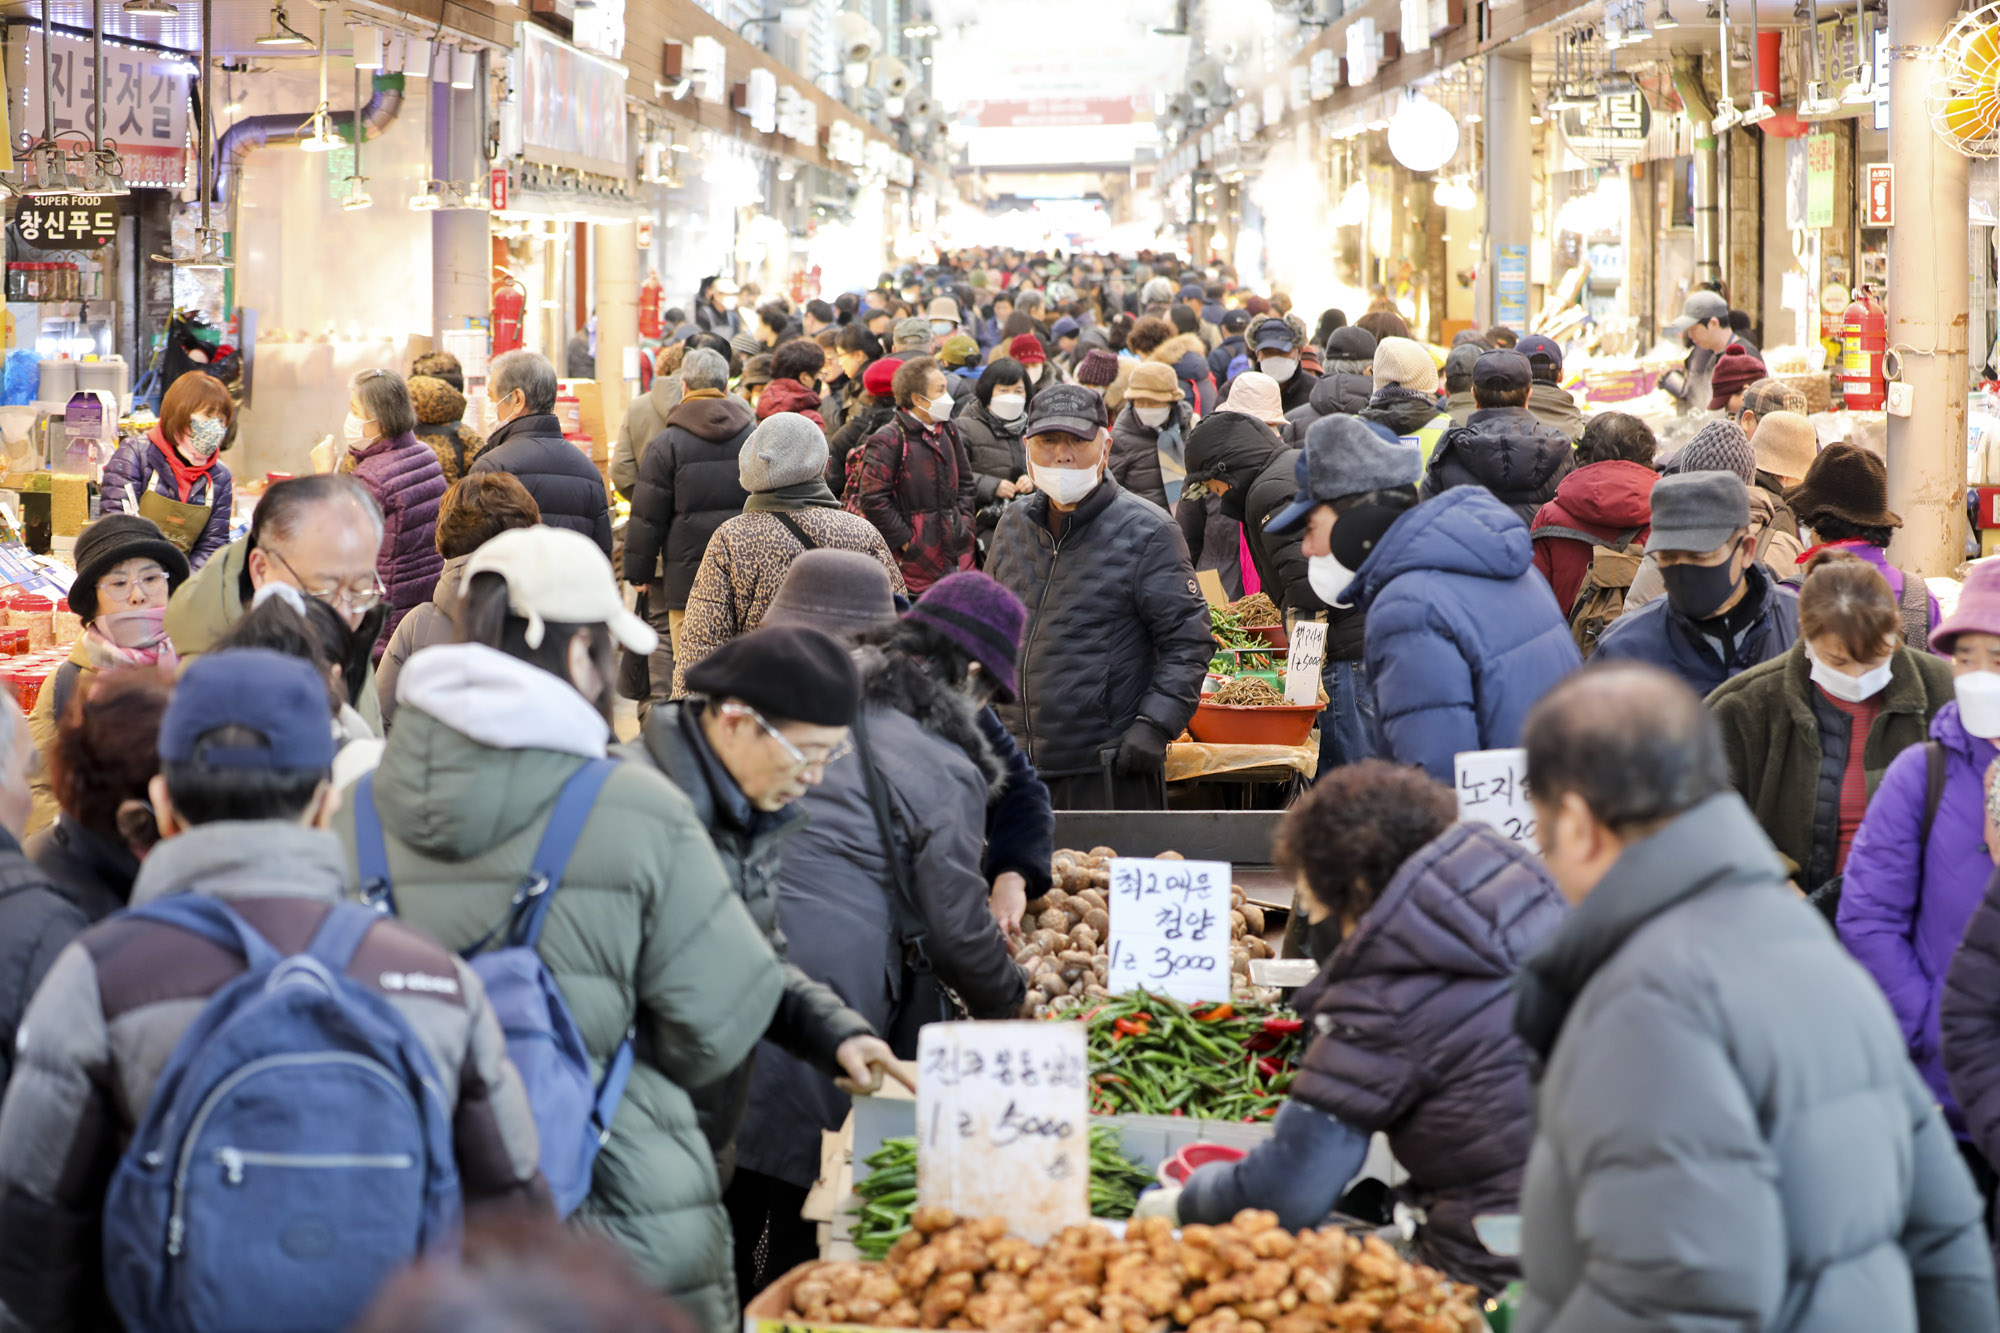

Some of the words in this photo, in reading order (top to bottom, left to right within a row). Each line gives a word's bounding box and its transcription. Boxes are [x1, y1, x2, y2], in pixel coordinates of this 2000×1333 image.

[50, 51, 177, 139] 진광젓갈
[34, 196, 68, 206] SUPER
[71, 196, 101, 206] FOOD
[19, 211, 116, 240] 창신푸드
